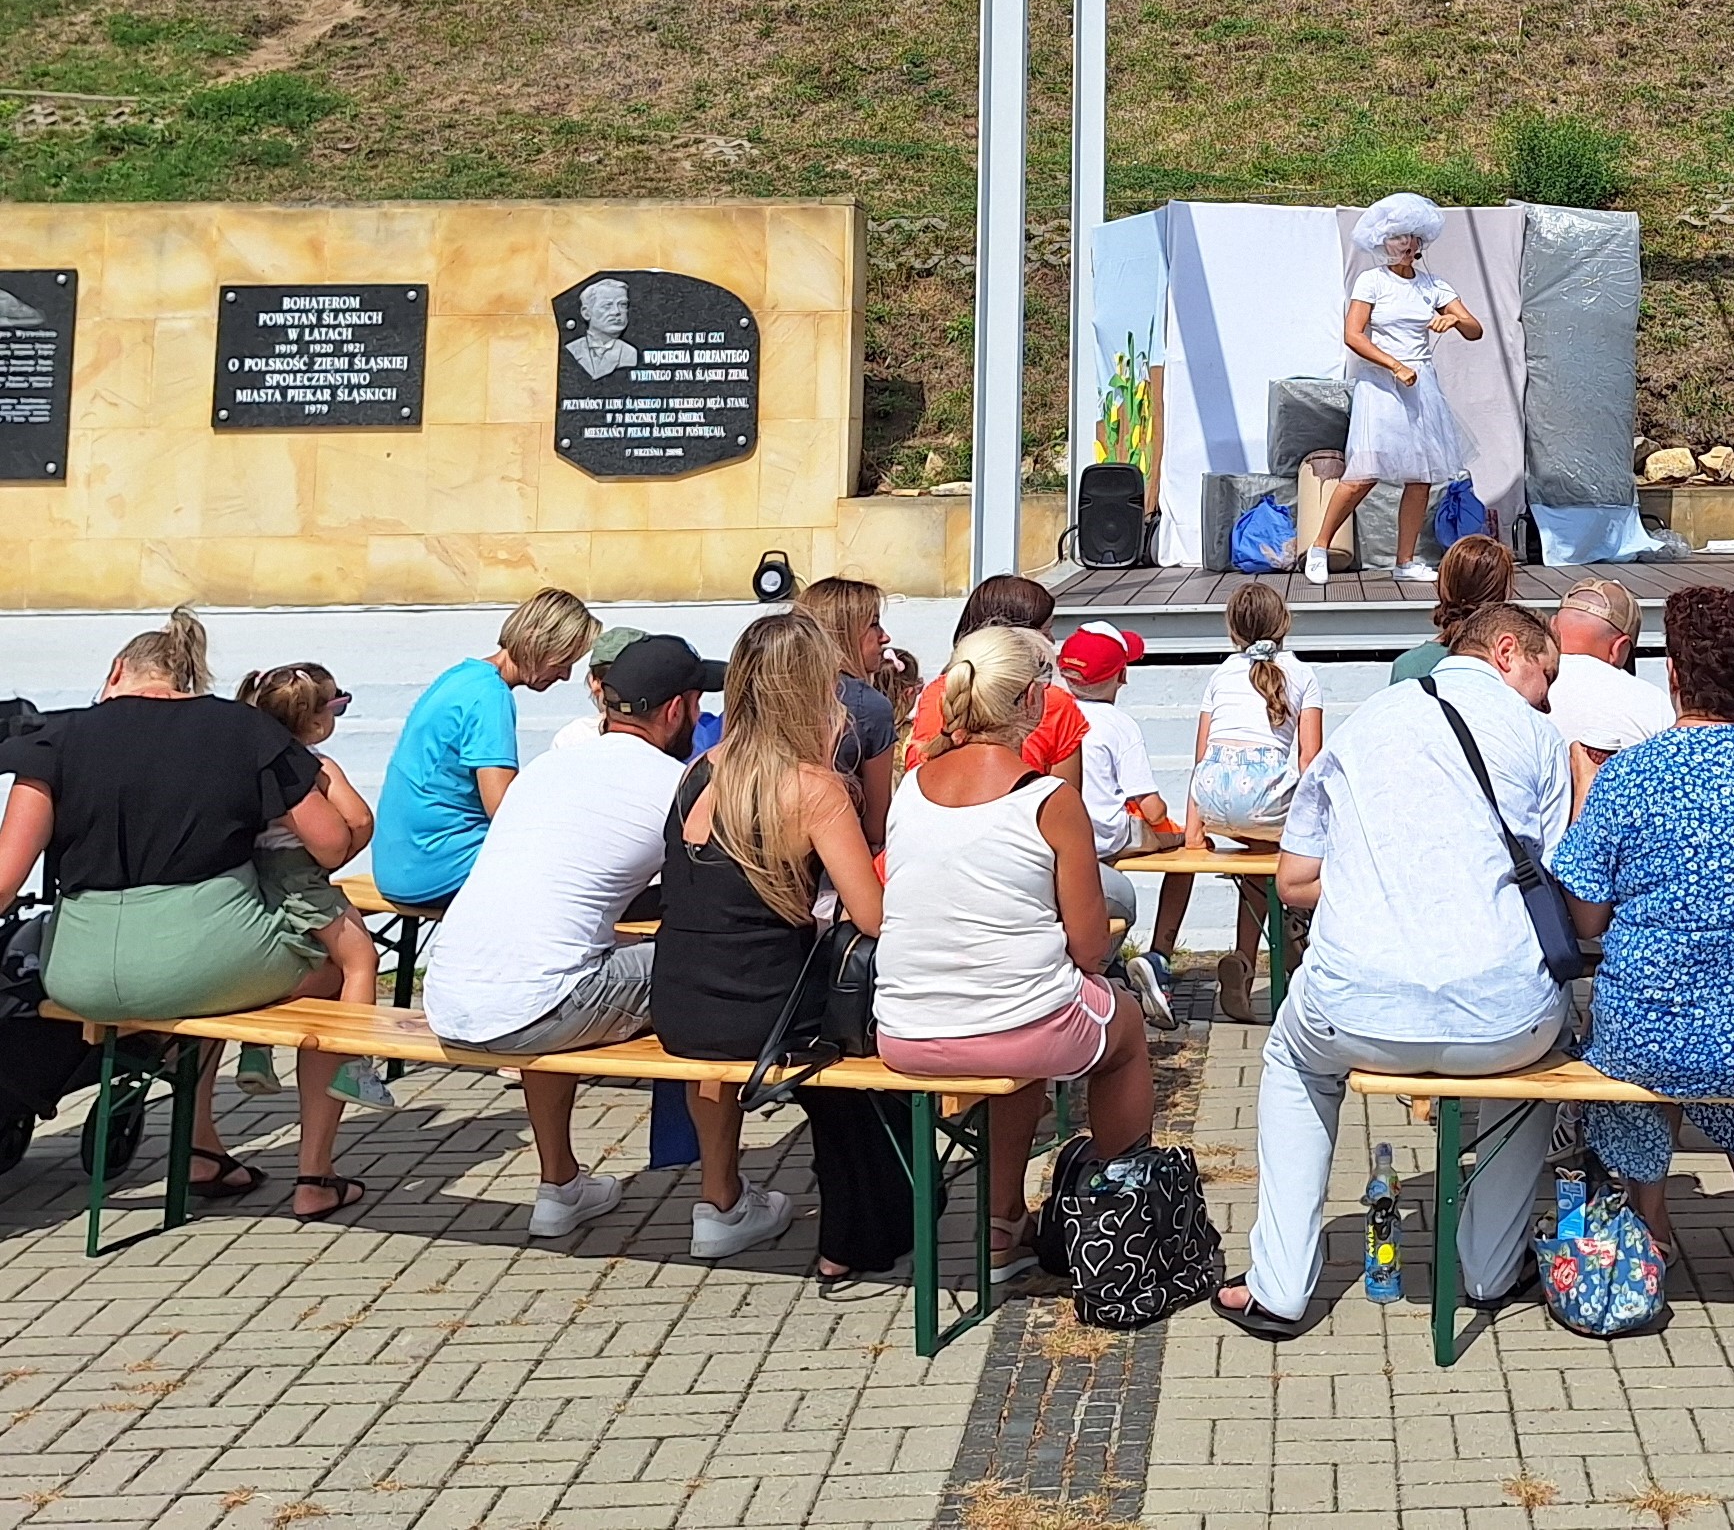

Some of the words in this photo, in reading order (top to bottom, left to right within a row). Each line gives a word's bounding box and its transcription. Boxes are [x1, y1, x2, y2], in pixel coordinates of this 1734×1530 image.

[282, 296, 360, 310] BOHATEROM
[258, 309, 317, 326] POWSTAŃ
[322, 310, 383, 327] ŚLĄSKICH
[288, 328, 299, 340] W
[305, 328, 352, 340] LATACH
[696, 332, 706, 344] KU
[708, 332, 725, 343] CZCI
[275, 344, 298, 354] 1919
[309, 344, 333, 353] 1920
[343, 343, 364, 353] 1921
[228, 358, 239, 371] O
[244, 355, 309, 371] POLSKOŚĆ
[313, 357, 348, 370] ZIEMI
[354, 354, 408, 372] ŚLĄSKIEJ
[643, 350, 690, 365] WOJCIECHA
[693, 349, 749, 363] KORFANTEGO
[630, 369, 671, 382] WYBITNEGO
[675, 369, 693, 381] SYNA
[236, 389, 282, 403] MIASTA
[287, 389, 331, 402] PIEKAR
[337, 386, 397, 404] ŚLĄSKICH
[304, 404, 328, 414] 1979
[626, 396, 661, 411] ŚLĄSKIEGO
[663, 398, 667, 408] I
[669, 398, 704, 409] WIELKIEGO
[606, 414, 613, 424] W
[627, 427, 650, 438] PIEKAR
